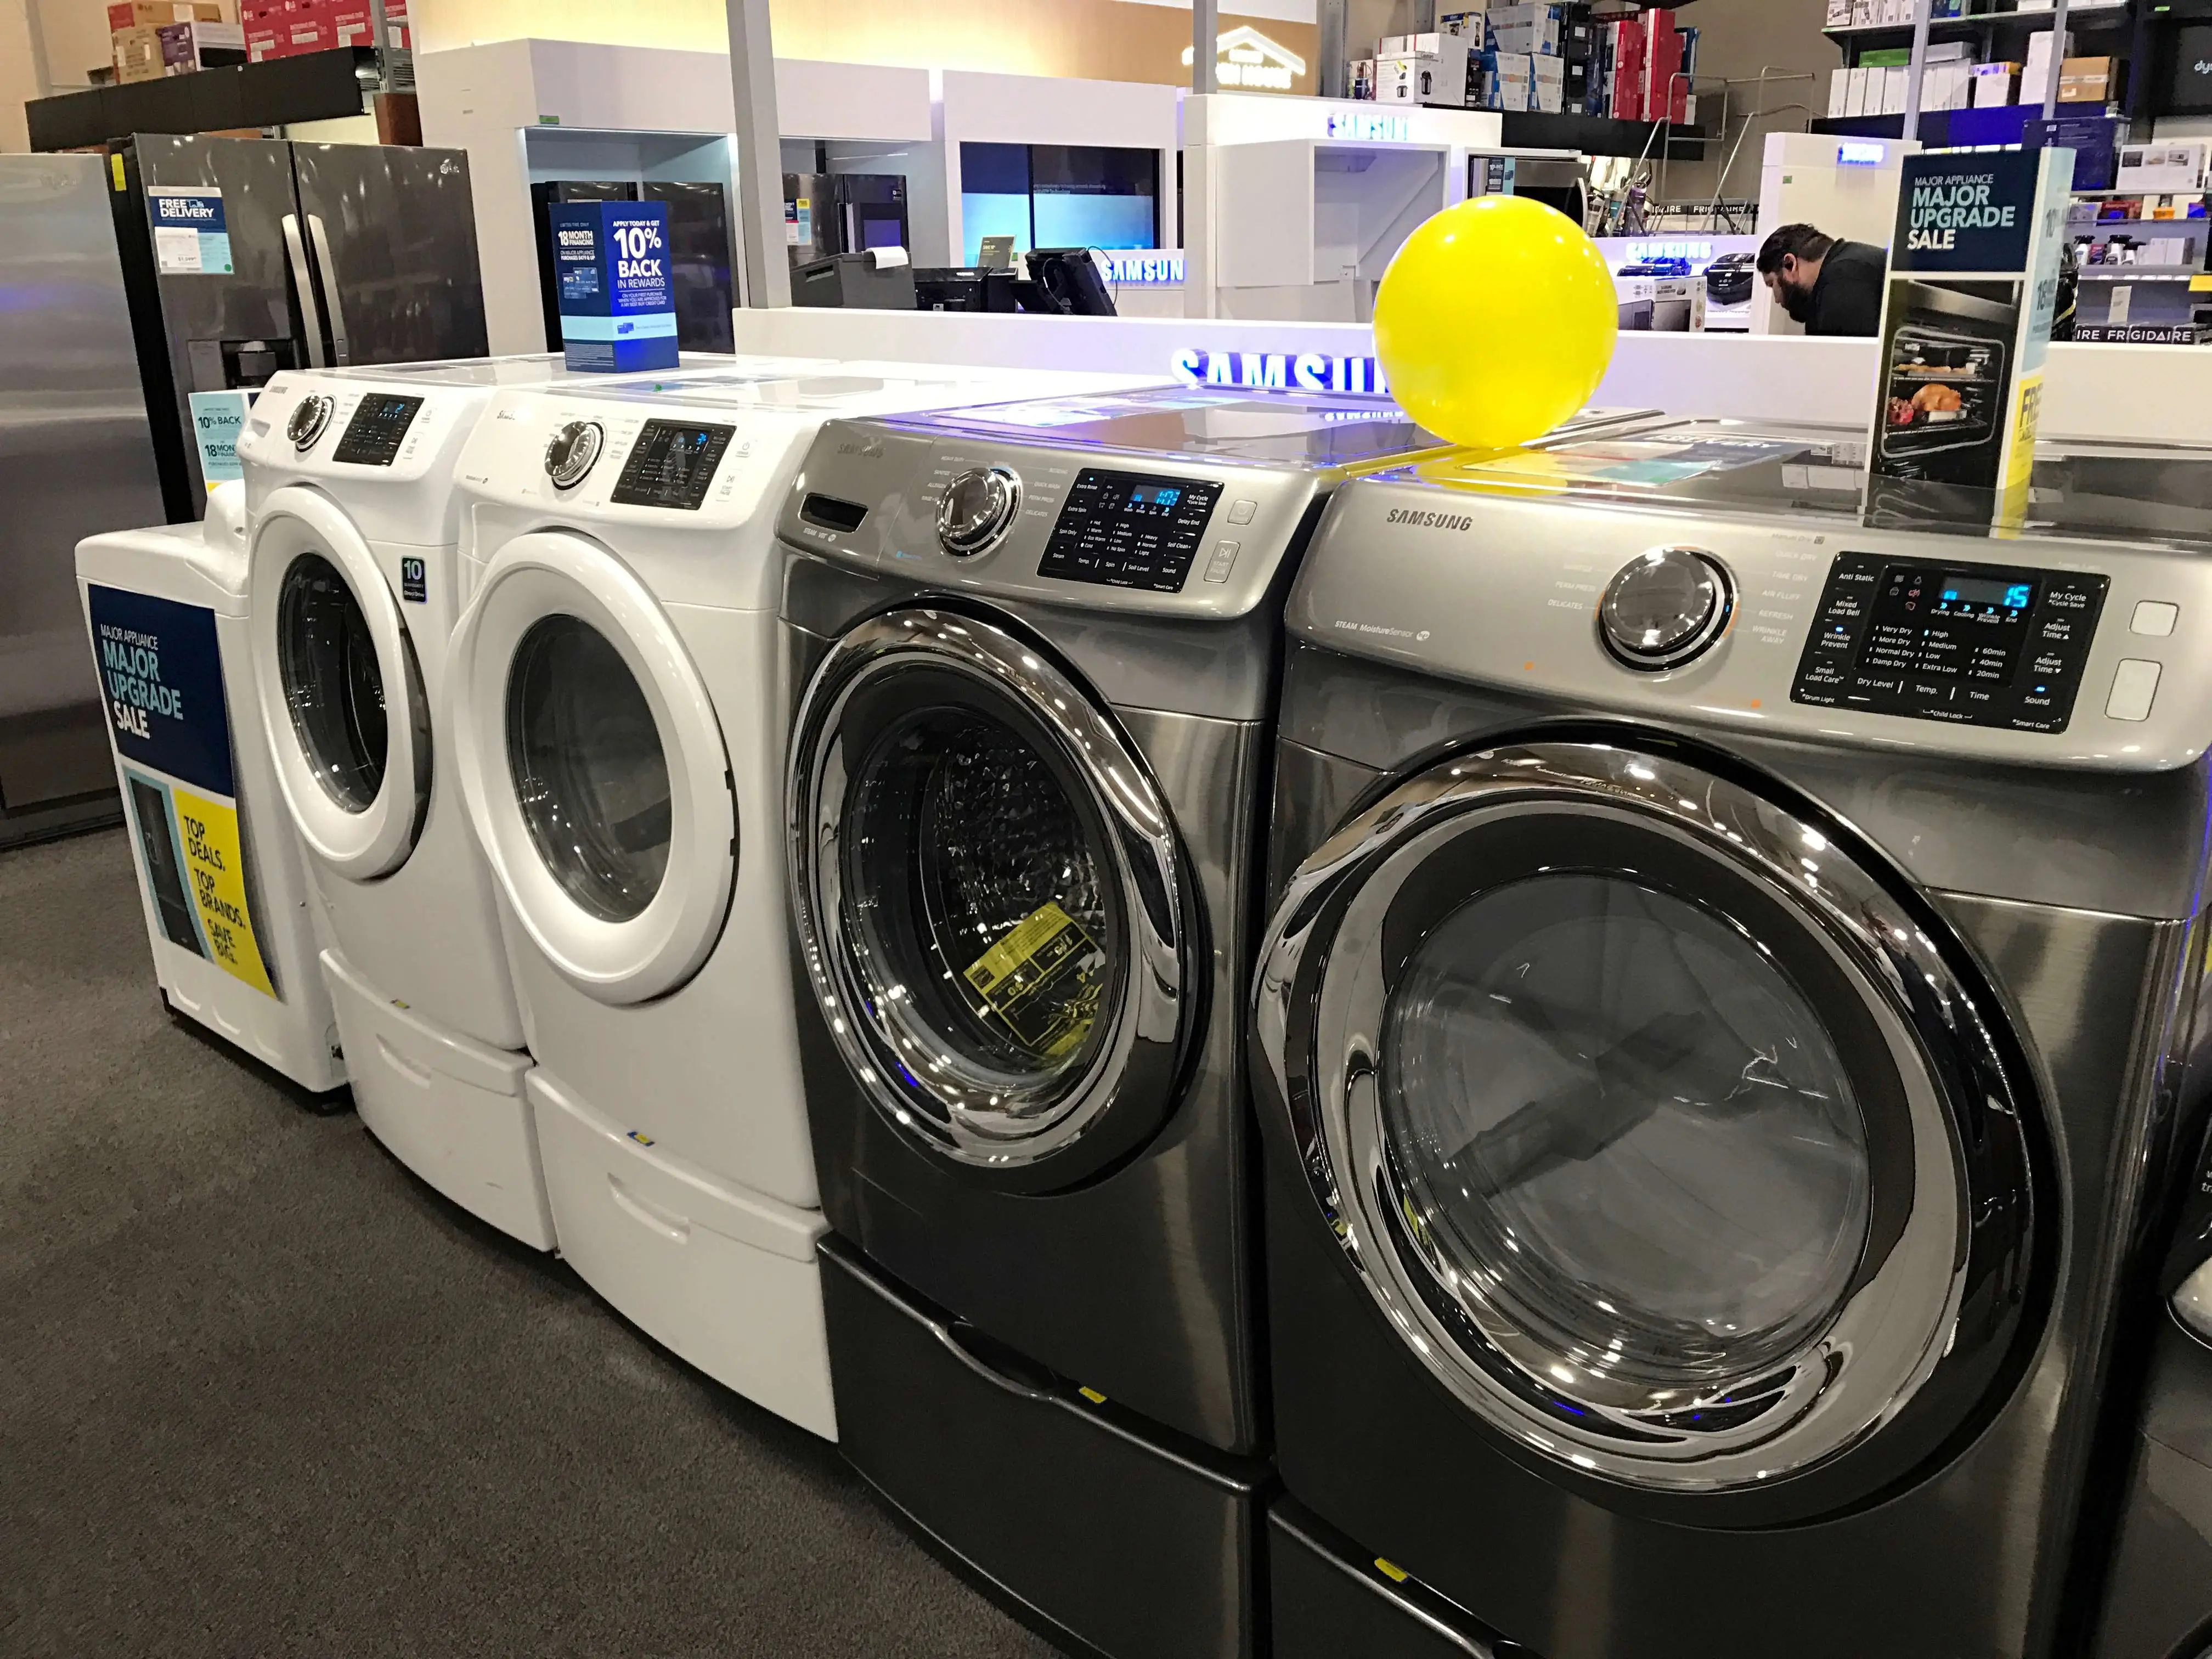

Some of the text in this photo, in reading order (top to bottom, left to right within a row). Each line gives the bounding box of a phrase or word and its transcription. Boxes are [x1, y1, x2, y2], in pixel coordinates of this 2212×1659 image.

[1329, 113, 1409, 139] SAMSUN
[1915, 173, 1994, 186] MAJOR APPLIANCE
[1912, 185, 1990, 207] MAJOR
[159, 199, 187, 208] FREE
[160, 208, 215, 217] DELIVERY
[1910, 206, 2016, 228] UPGRADE
[558, 231, 568, 246] 18
[568, 230, 593, 239] MONTH
[1907, 229, 1956, 250] SALE
[613, 227, 662, 259] 10%
[1626, 241, 1712, 259] SAMSUNG
[618, 259, 662, 278] BACK
[1101, 259, 1184, 281] SAMSUN
[617, 277, 665, 289] IN REWARDS
[2076, 330, 2100, 340] IRE
[1171, 348, 1389, 394] SAMSU
[198, 416, 241, 428] 10% BACK
[205, 445, 217, 456] 18
[1386, 509, 1473, 531] SAMSUNG
[404, 560, 422, 580] 10
[1772, 571, 1791, 579] TIME
[1854, 574, 1875, 582] Static
[1776, 591, 1802, 600] FLUFF
[2004, 586, 2029, 608] 15
[2050, 591, 2087, 602] My Cycle
[1548, 599, 1584, 610] DELICATES
[1836, 600, 1858, 608] Mixed
[1759, 609, 1794, 620] REFRESH
[1846, 608, 1860, 617] Bell
[1931, 608, 1950, 616] Drying
[1954, 610, 1975, 619] Cooling
[1335, 620, 1414, 638] STEAM MoistureSensor
[1752, 625, 1788, 636] WRINKLE
[1883, 625, 1912, 635] Very Dry
[2044, 622, 2070, 631] Adjust
[100, 623, 159, 651] MAJOR APPLIANCE
[1760, 635, 1785, 645] AWAY
[1824, 631, 1851, 641] Wrinkle
[1932, 630, 1949, 639] High
[2042, 630, 2062, 639] Time
[1821, 640, 1848, 649] Prevent
[1897, 637, 1910, 646] Dry
[1928, 641, 1957, 650] Medium
[1876, 646, 1915, 658] Normal Dry
[1982, 647, 2006, 657] 60min
[103, 639, 161, 682] MAJOR
[1873, 657, 1907, 668] Damp Dry
[1979, 659, 2003, 668] 40min
[2035, 657, 2062, 666] Adjust
[1815, 667, 1835, 675] Small
[1922, 663, 1941, 671] Extra
[2034, 665, 2053, 674] Time
[1805, 673, 1822, 681] Load
[1976, 670, 2000, 679] 20min
[1857, 678, 1893, 689] Dry Level
[108, 670, 183, 720] UPGRADE
[1916, 685, 1938, 695] Temp.
[1820, 696, 1835, 704] Light
[1970, 691, 1990, 701] Time
[2024, 696, 2050, 706] Sound
[113, 701, 150, 739] SALE
[183, 815, 205, 838] TOP
[188, 838, 225, 872] DEALS.
[194, 868, 215, 891] TOP
[200, 889, 246, 929] BRANDS.
[207, 918, 236, 949] SAVE
